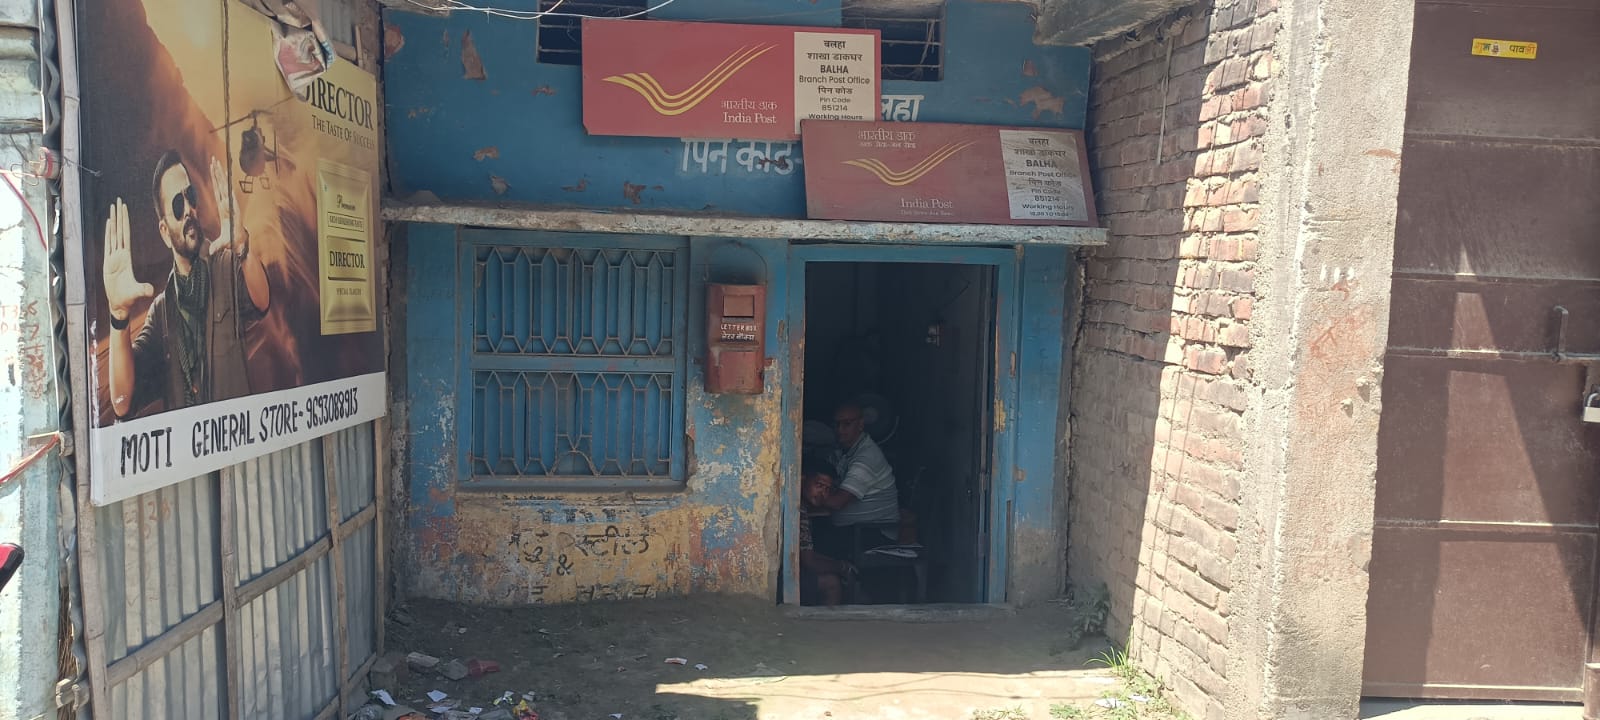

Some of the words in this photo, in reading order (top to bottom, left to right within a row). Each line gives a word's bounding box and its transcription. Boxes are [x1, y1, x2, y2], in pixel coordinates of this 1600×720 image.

[807, 52, 830, 61] शाखा
[832, 53, 863, 62] डाकघर
[820, 64, 849, 74] BALHA
[799, 75, 827, 83] Branch
[829, 75, 846, 84] Post
[847, 76, 871, 84] Office
[818, 85, 833, 95] पिन
[834, 86, 853, 95] कोड
[721, 97, 755, 110] भारतीय
[758, 101, 778, 111] डाक
[723, 111, 752, 123] India
[754, 112, 777, 124] Post
[311, 114, 325, 133] THE
[327, 121, 343, 140] TASTE
[858, 127, 893, 141] भारतीय
[896, 131, 916, 141] डाक
[1026, 159, 1058, 168] BALHA
[901, 197, 929, 209] India
[930, 198, 953, 209] Post
[329, 250, 365, 269] DIRECTOR
[720, 323, 745, 332] LETTER
[120, 426, 173, 478] MOTI
[191, 410, 255, 459] GENERAL
[305, 387, 359, 430] 9693088913
